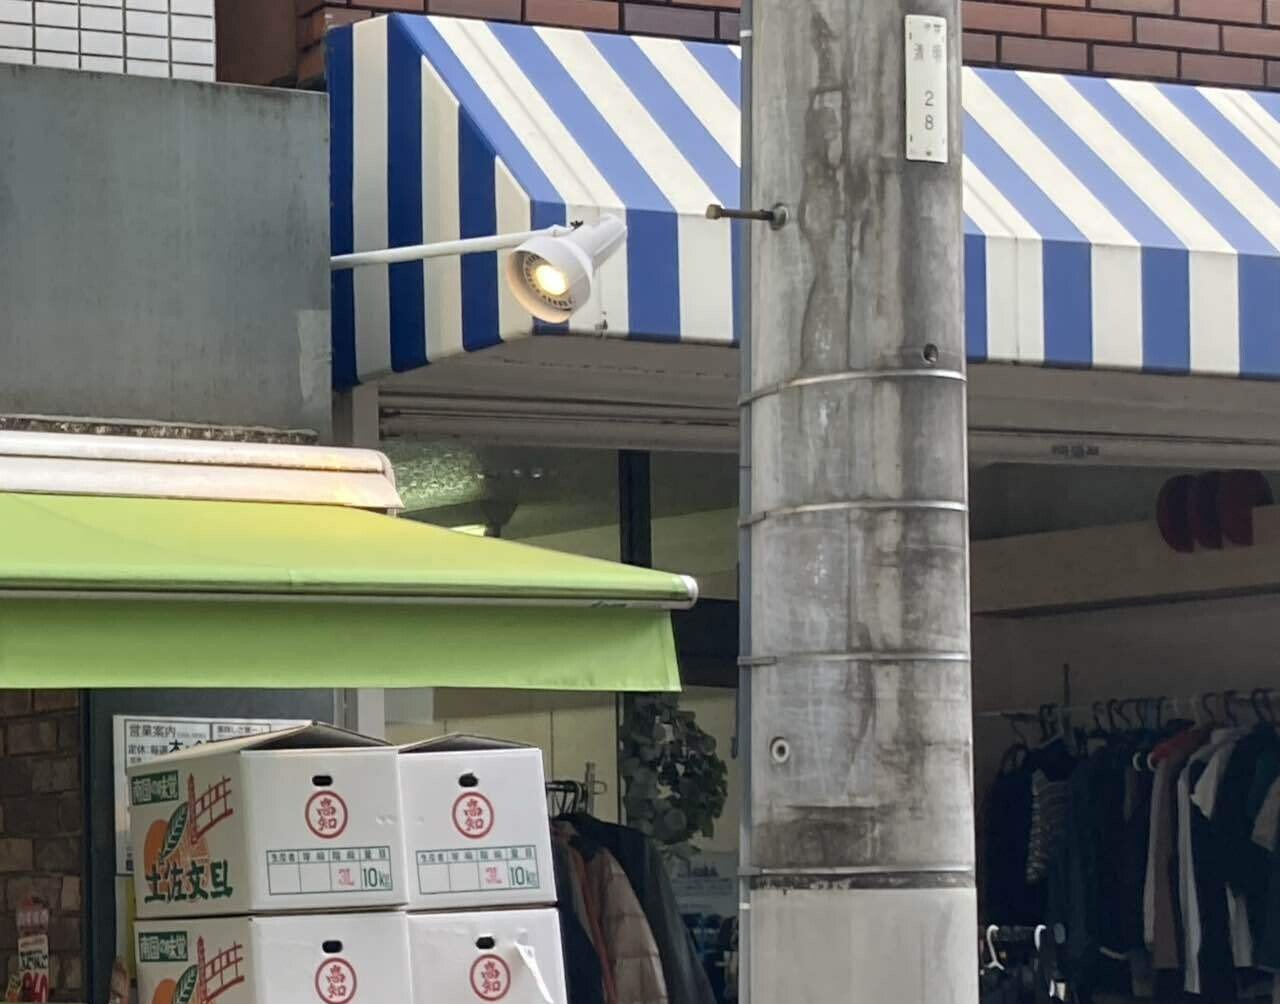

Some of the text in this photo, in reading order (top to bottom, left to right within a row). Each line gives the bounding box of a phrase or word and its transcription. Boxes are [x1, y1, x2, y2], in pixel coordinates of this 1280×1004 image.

[316, 797, 337, 832] 高知
[463, 798, 484, 832] 高知
[144, 858, 233, 904] 土佐文旦
[139, 933, 188, 961] 南国の味覚
[326, 964, 347, 998] 高知
[481, 960, 501, 994] 高知
